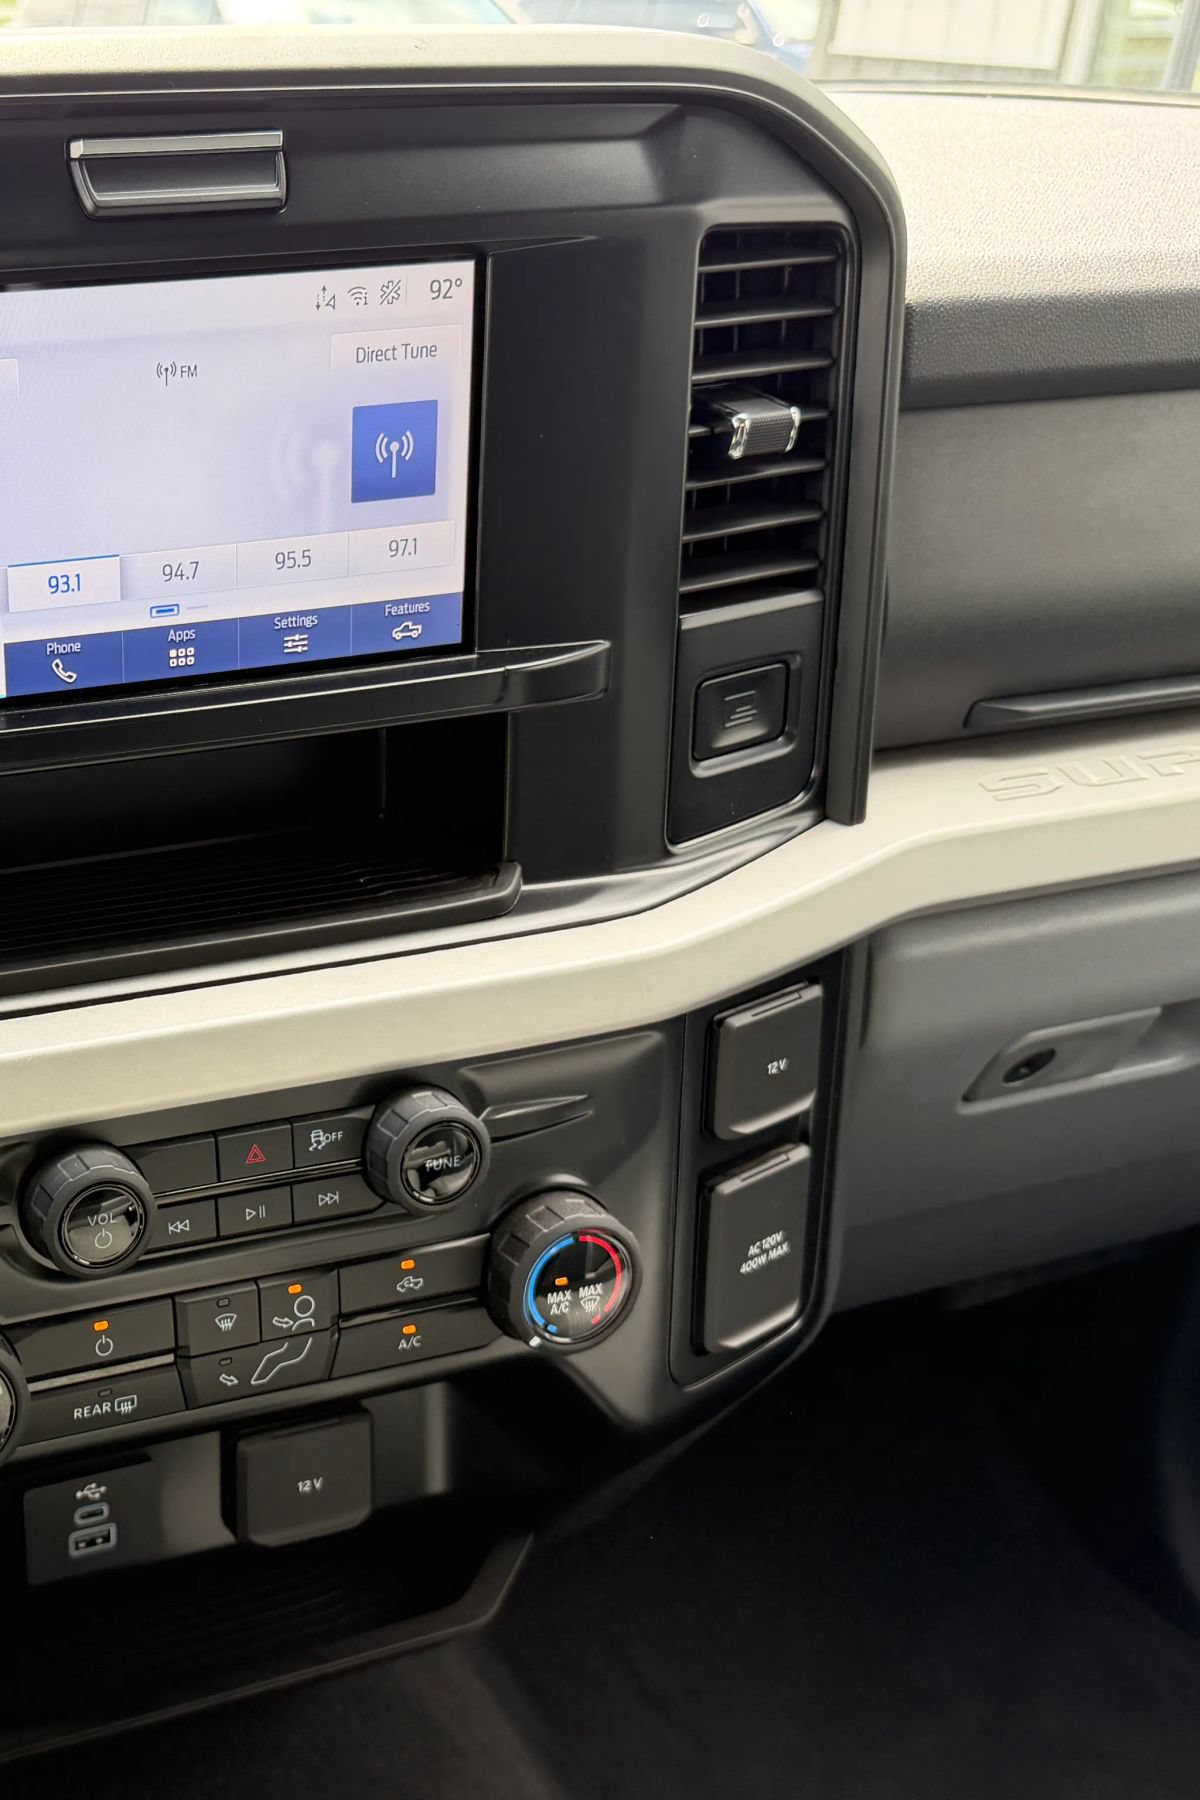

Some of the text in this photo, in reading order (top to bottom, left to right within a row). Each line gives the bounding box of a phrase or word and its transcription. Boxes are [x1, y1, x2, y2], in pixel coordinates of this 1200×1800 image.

[355, 343, 438, 364] Direct Tune
[179, 364, 198, 379] FM
[387, 536, 419, 559] 97.1
[274, 548, 312, 571] 95.5
[161, 560, 200, 583] 94.7
[46, 573, 82, 596] 93.1
[384, 600, 430, 617] Features
[273, 612, 319, 633] Settings
[168, 627, 197, 646] Apps
[45, 640, 82, 658] Phone
[767, 1058, 788, 1075] 12V
[323, 1131, 344, 1143] OFF
[424, 1155, 462, 1172] TUNE
[87, 1212, 117, 1226] VOL
[748, 1229, 785, 1257] AC 120V
[739, 1242, 791, 1274] 400W MAX
[547, 1289, 572, 1305] MAX
[578, 1282, 603, 1298] MAX
[550, 1300, 569, 1315] A/C
[398, 1335, 422, 1350] A/C
[73, 1401, 112, 1420] REAR
